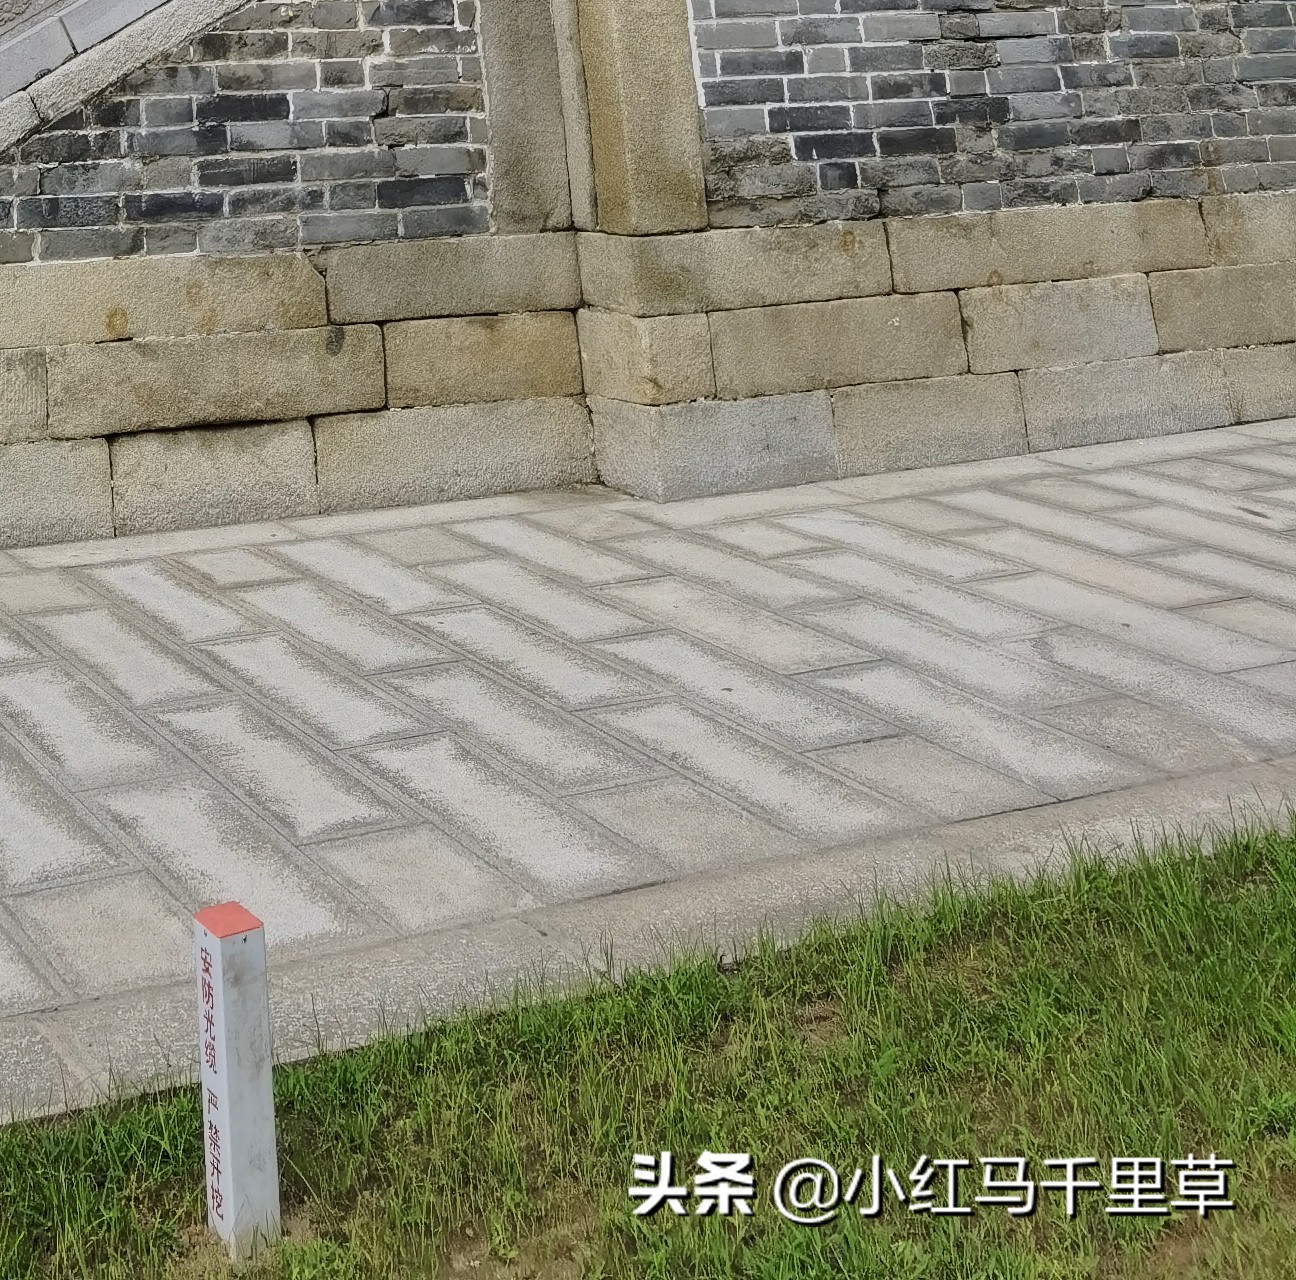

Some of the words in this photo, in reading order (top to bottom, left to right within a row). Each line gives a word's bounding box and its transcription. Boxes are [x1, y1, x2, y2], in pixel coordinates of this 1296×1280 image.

[200, 946, 217, 1075] 安防光缆
[206, 1087, 224, 1221] 严禁开挖
